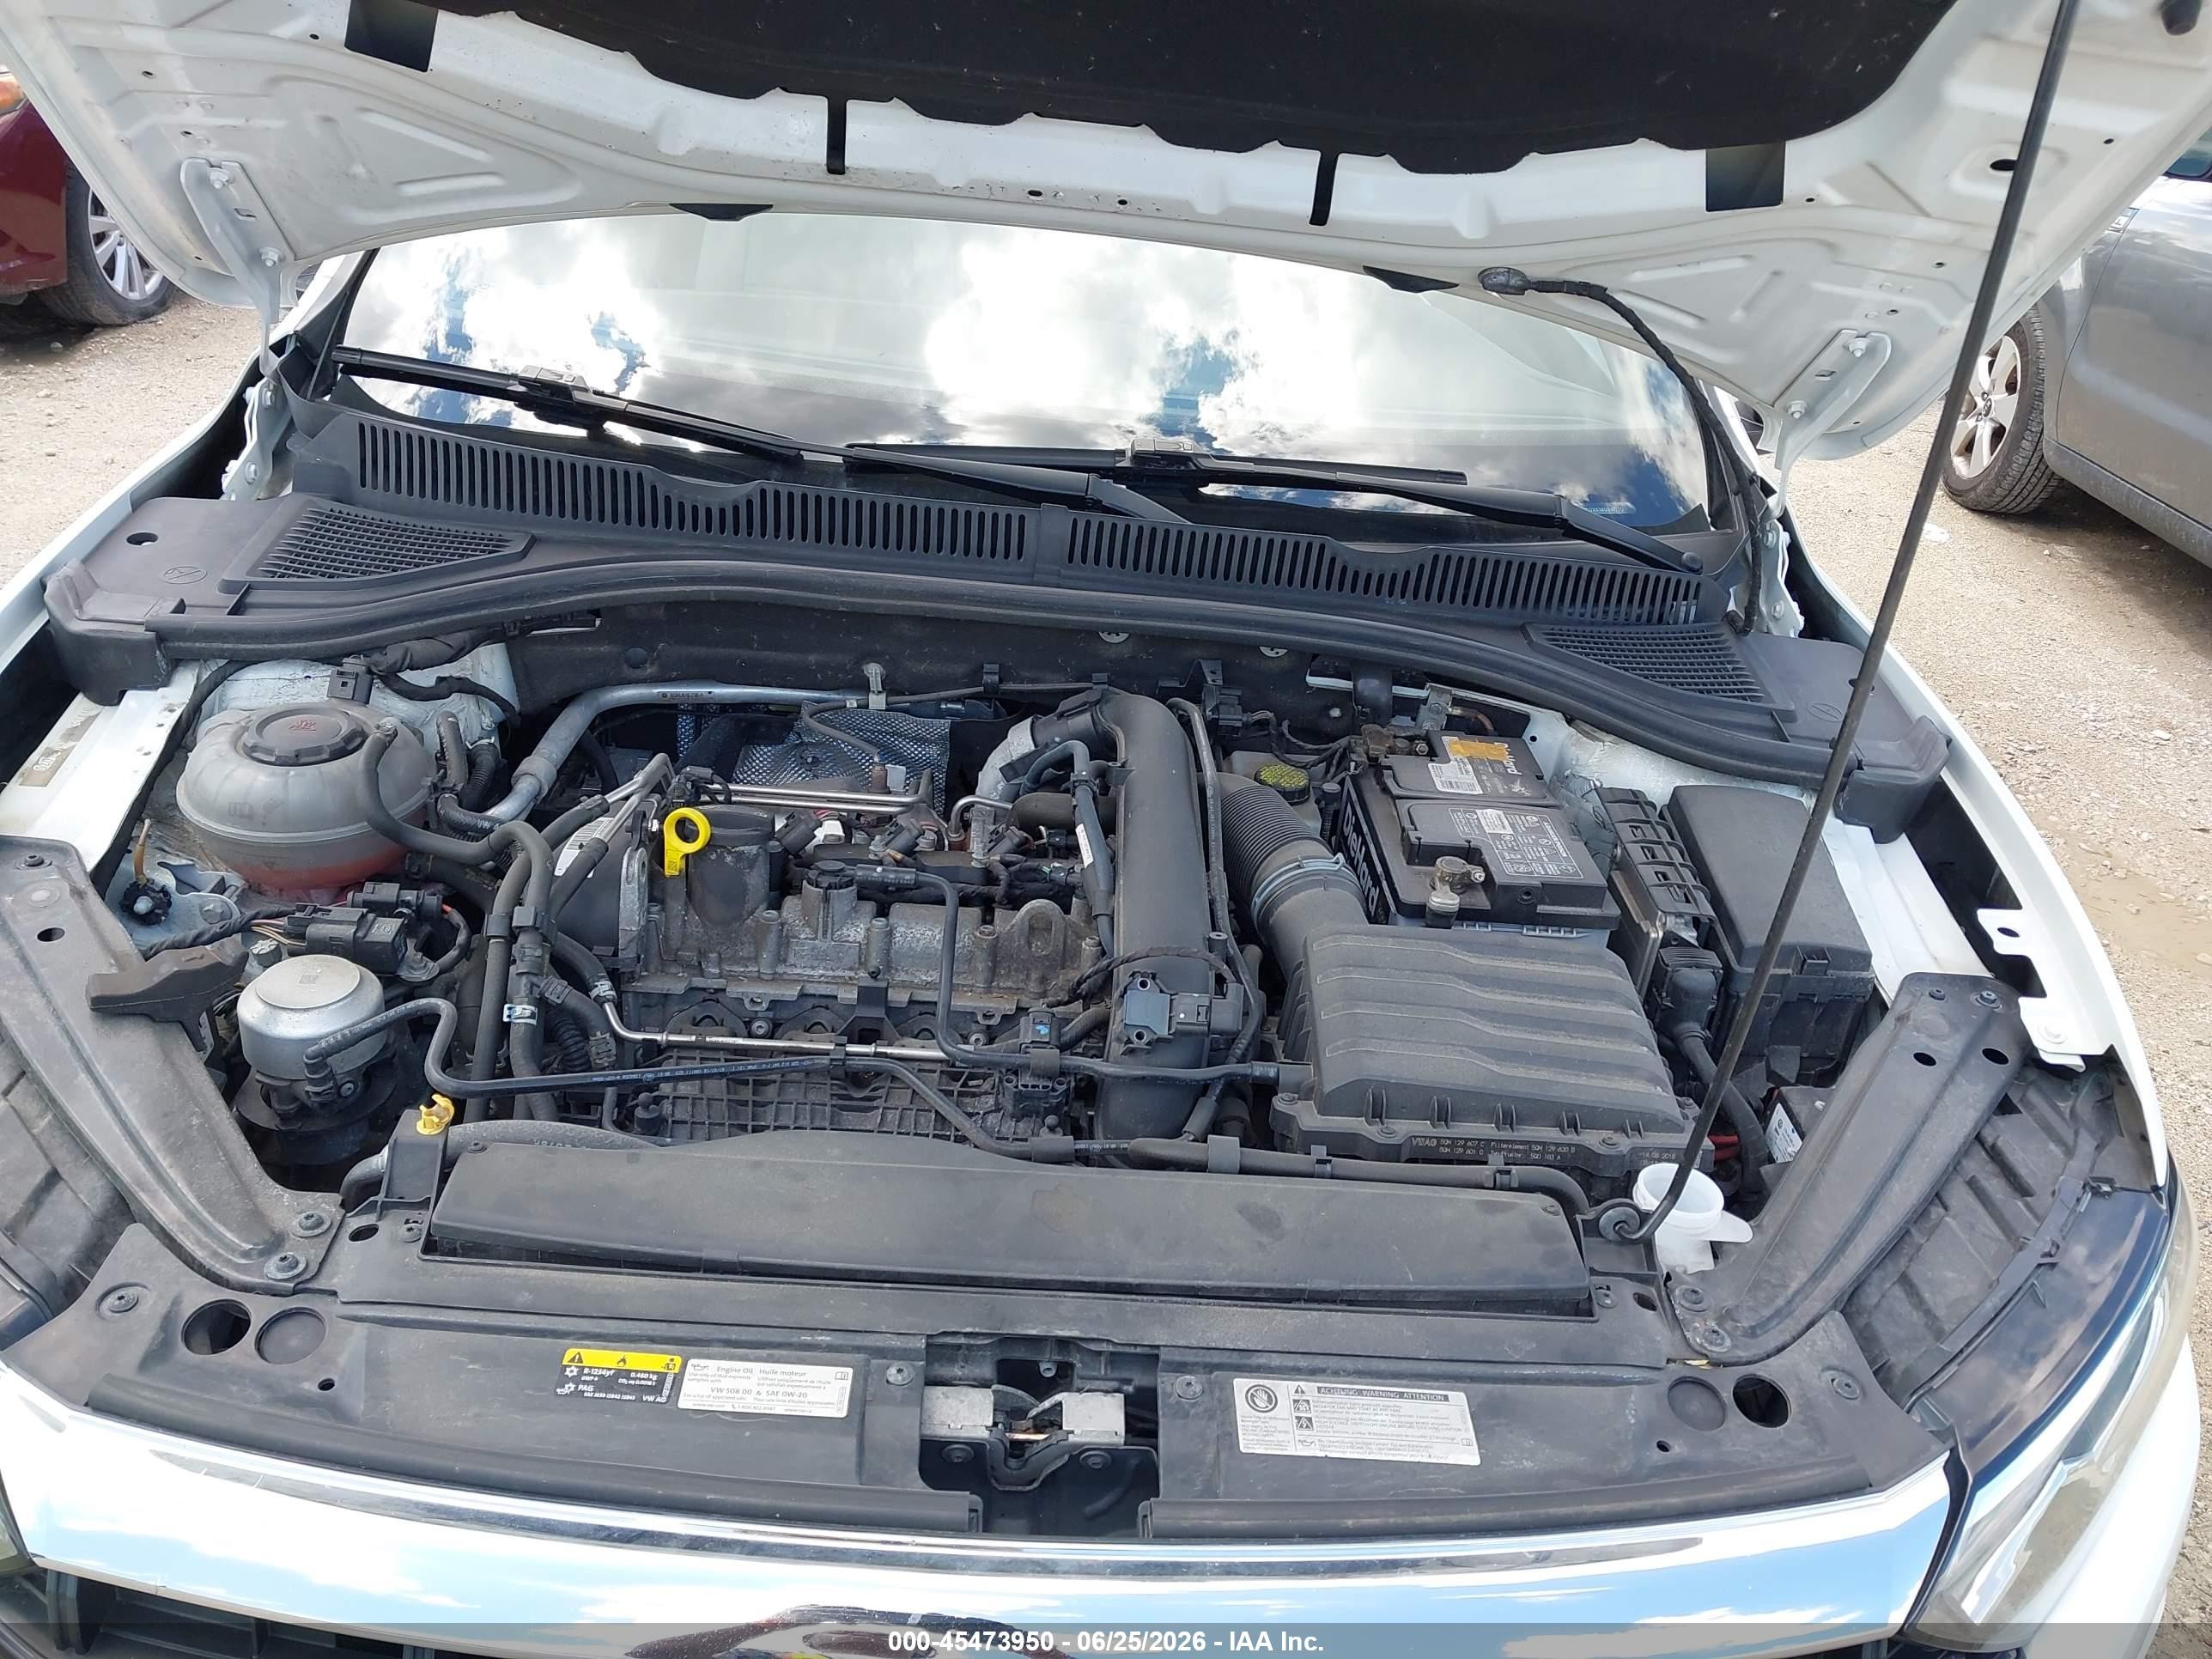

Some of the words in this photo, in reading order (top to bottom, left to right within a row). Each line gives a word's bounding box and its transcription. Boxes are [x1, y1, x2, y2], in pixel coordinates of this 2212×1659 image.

[1343, 802, 1380, 918] DieHard
[583, 1368, 615, 1377] R-1234yf
[1321, 1387, 1358, 1395] ACHTUNG
[1361, 1389, 1400, 1398] WARNING
[1403, 1392, 1445, 1401] ATTENTION
